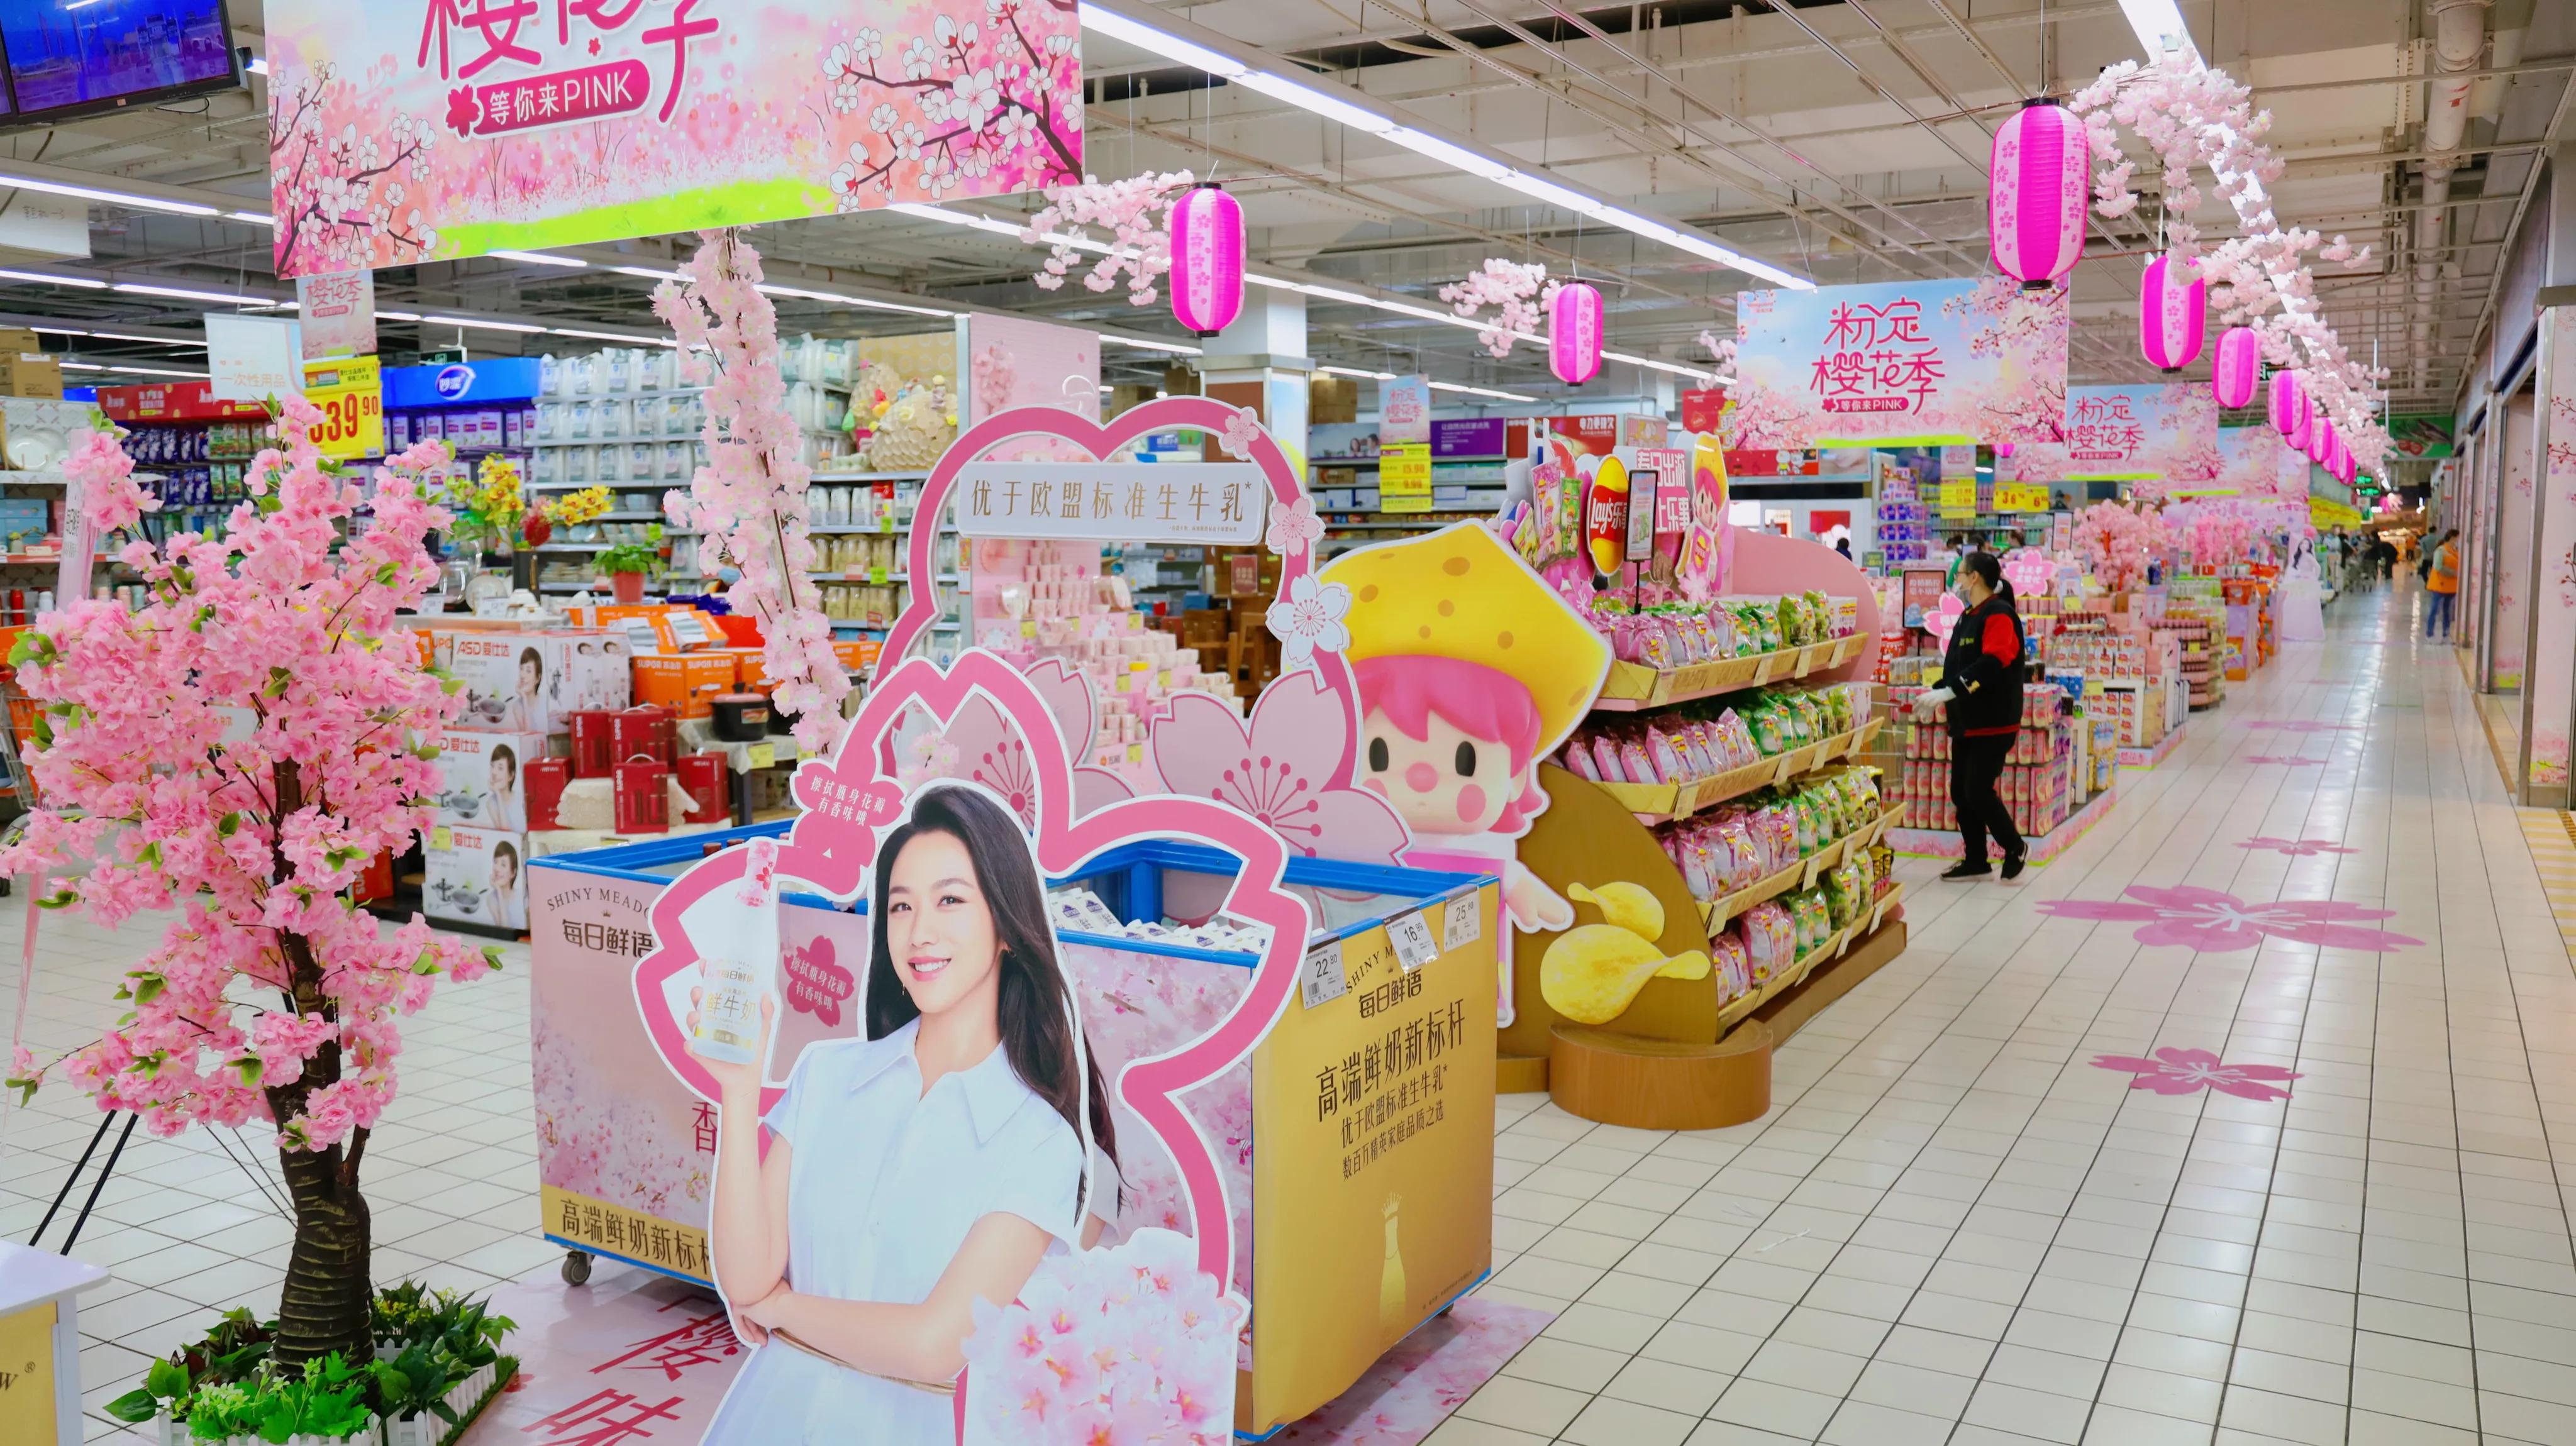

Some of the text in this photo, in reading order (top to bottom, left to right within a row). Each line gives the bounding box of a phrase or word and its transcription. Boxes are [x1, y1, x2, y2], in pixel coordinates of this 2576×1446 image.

[489, 69, 633, 125] 等你来PINK
[305, 272, 363, 316] 樱花季
[1824, 297, 1930, 350] 粉定
[219, 372, 286, 388] 一次性用品
[1809, 346, 1946, 416] 樱花季
[362, 395, 379, 416] 90
[1841, 399, 1903, 410] 等你来PINK
[2071, 394, 2136, 424] 粉定
[2063, 422, 2146, 462] 樱花季
[1590, 497, 1614, 535] Lay's
[456, 641, 511, 658] ASD 爱仕达
[636, 660, 662, 670] SUPOR
[687, 660, 713, 670] SUPOR
[450, 737, 480, 754] 爱仕达
[810, 775, 886, 814] 擦拭瓶身花瓣
[818, 797, 869, 827] 有香味哦
[453, 832, 483, 849] 爱仕达
[546, 887, 592, 912] SHINY
[562, 919, 654, 958] 每日鲜语
[789, 954, 847, 996] 擦拭瓶身花瓣
[1345, 949, 1380, 995] SHINY
[704, 991, 757, 1021] 鲜牛奶
[794, 980, 834, 1012] 有香味哦
[1358, 968, 1423, 1019] 每日鲜语
[1315, 998, 1465, 1123] 高端鲜奶新标杆
[1342, 1099, 1445, 1183] 数百万精英家庭品质之选
